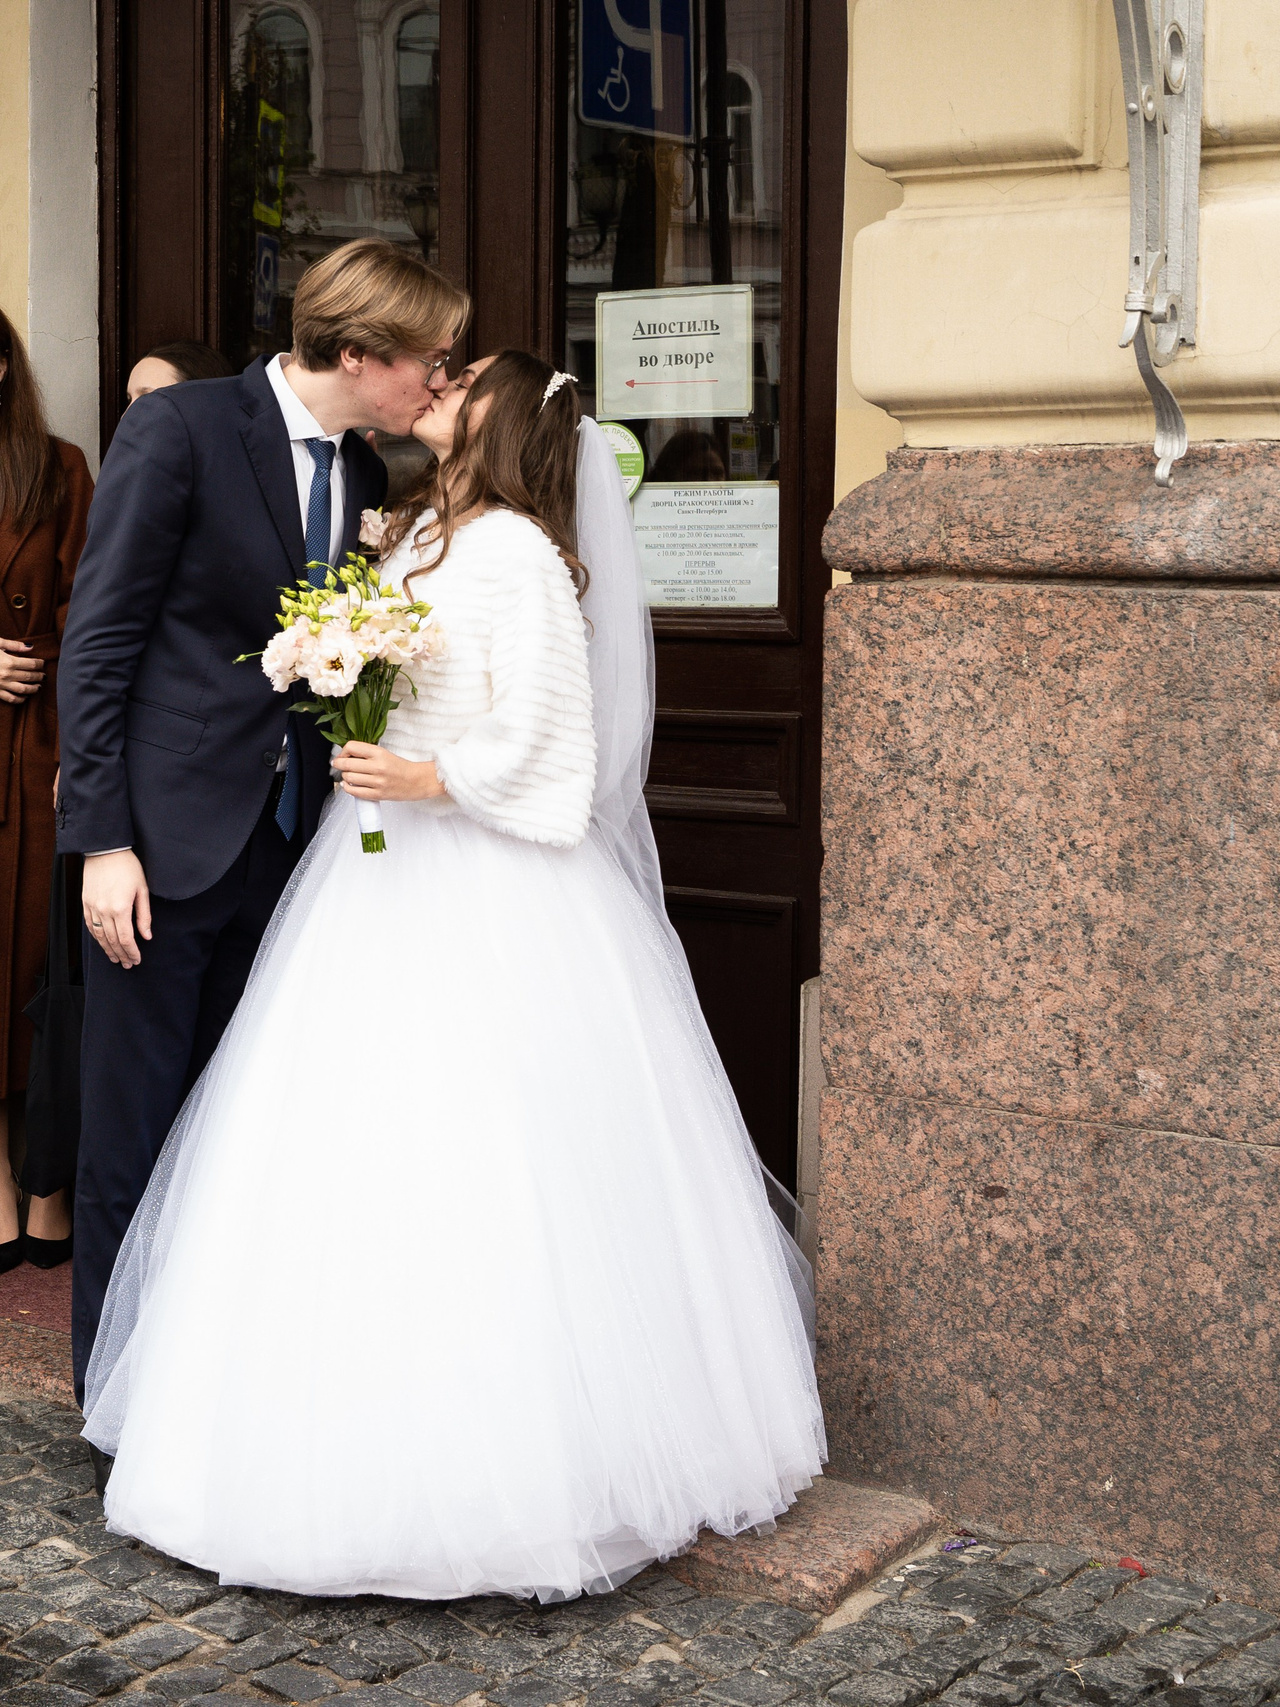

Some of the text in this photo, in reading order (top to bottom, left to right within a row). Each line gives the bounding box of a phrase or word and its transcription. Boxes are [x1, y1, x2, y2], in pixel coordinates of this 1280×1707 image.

[632, 319, 721, 338] Апостиль
[639, 351, 715, 369] во дворе
[611, 427, 637, 452] ПРОЕКТА
[685, 560, 716, 568] ПЕРЕРЫВ
